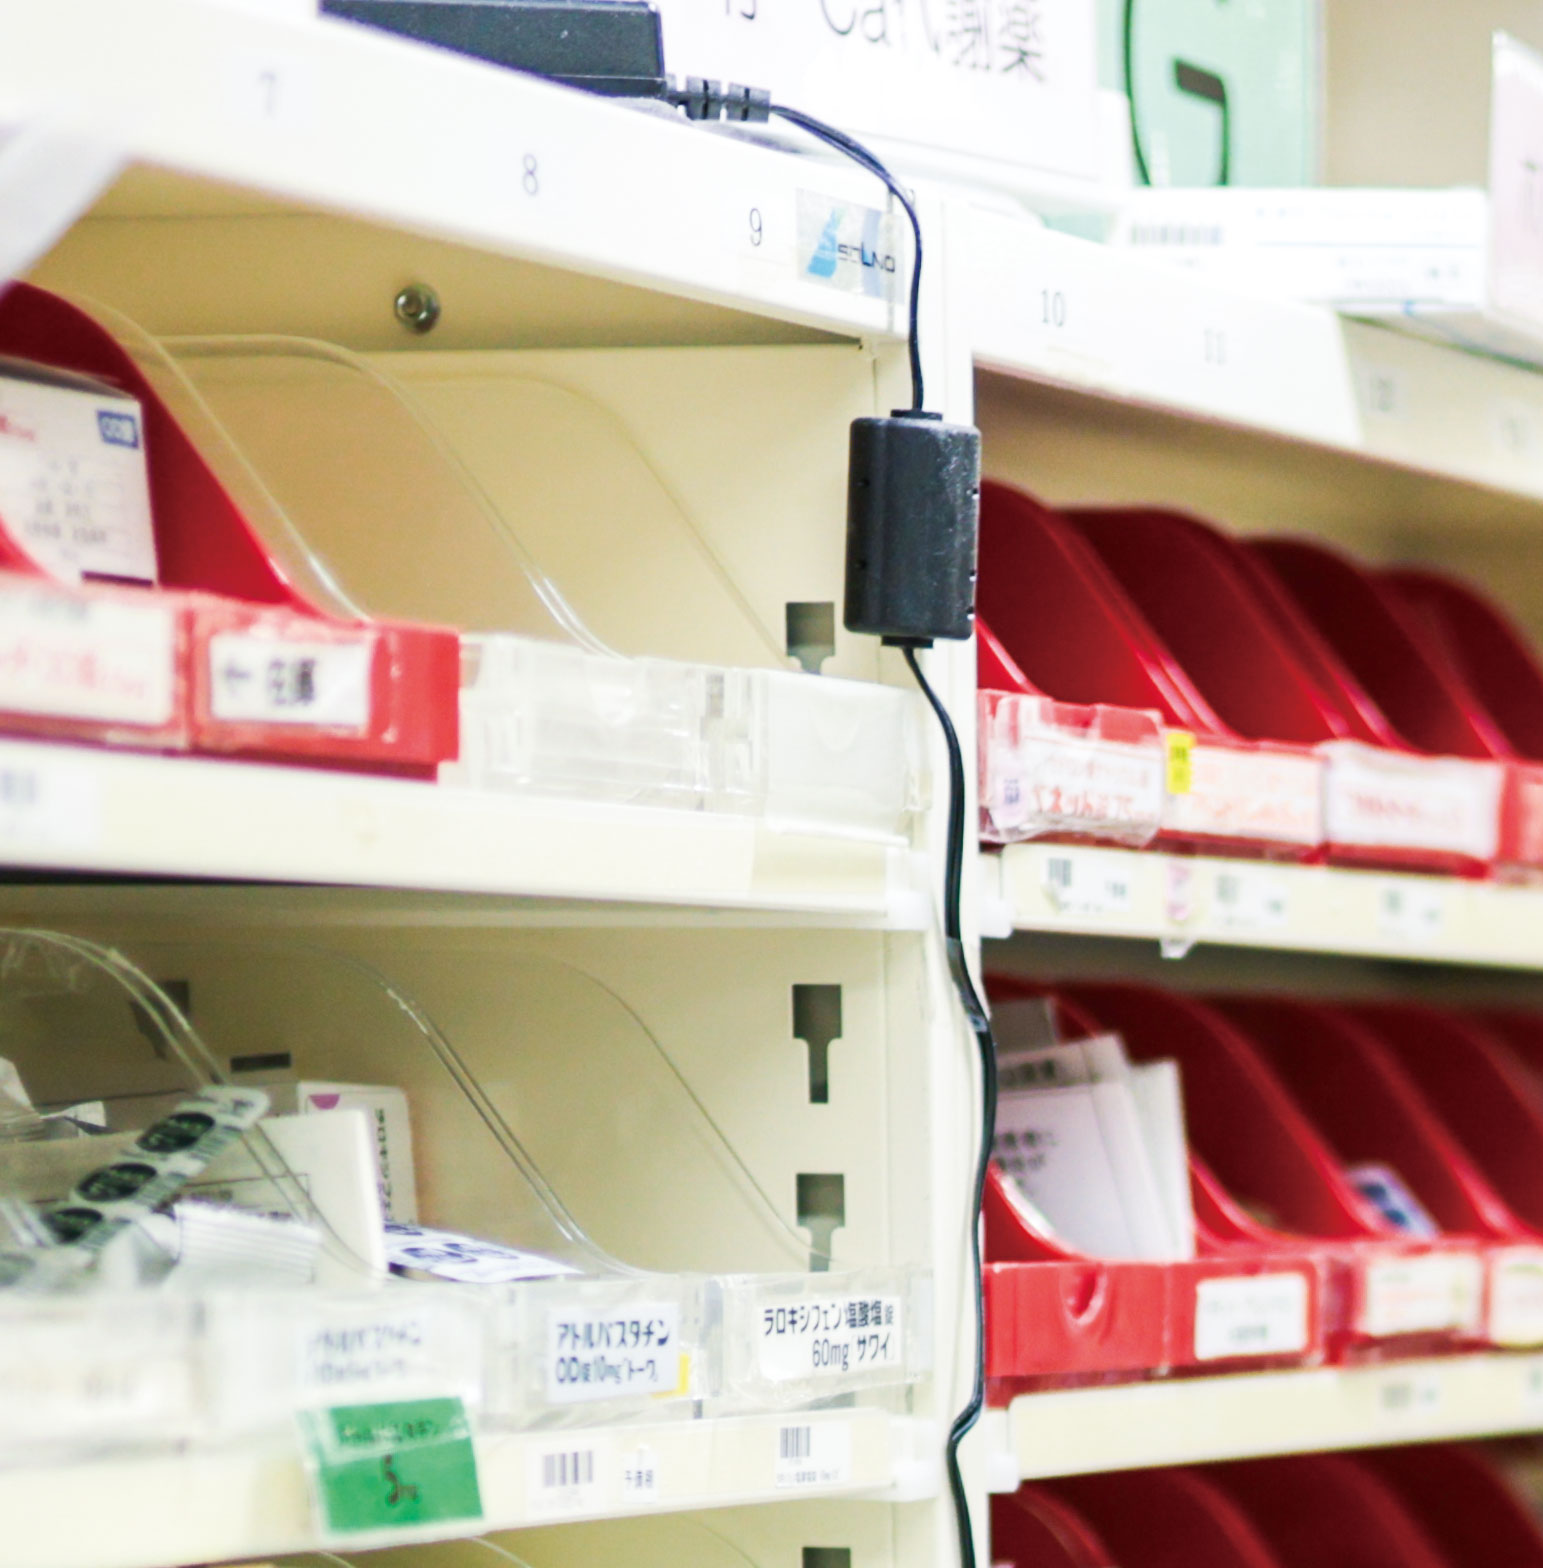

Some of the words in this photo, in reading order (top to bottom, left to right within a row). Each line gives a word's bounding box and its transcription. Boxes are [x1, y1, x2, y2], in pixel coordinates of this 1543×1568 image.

[521, 153, 540, 196] 8
[749, 207, 763, 246] 9
[1041, 289, 1066, 328] 10
[556, 1317, 672, 1351] アトルバスタチン
[763, 1299, 895, 1338] ラロキシフェン塩酸塩錠
